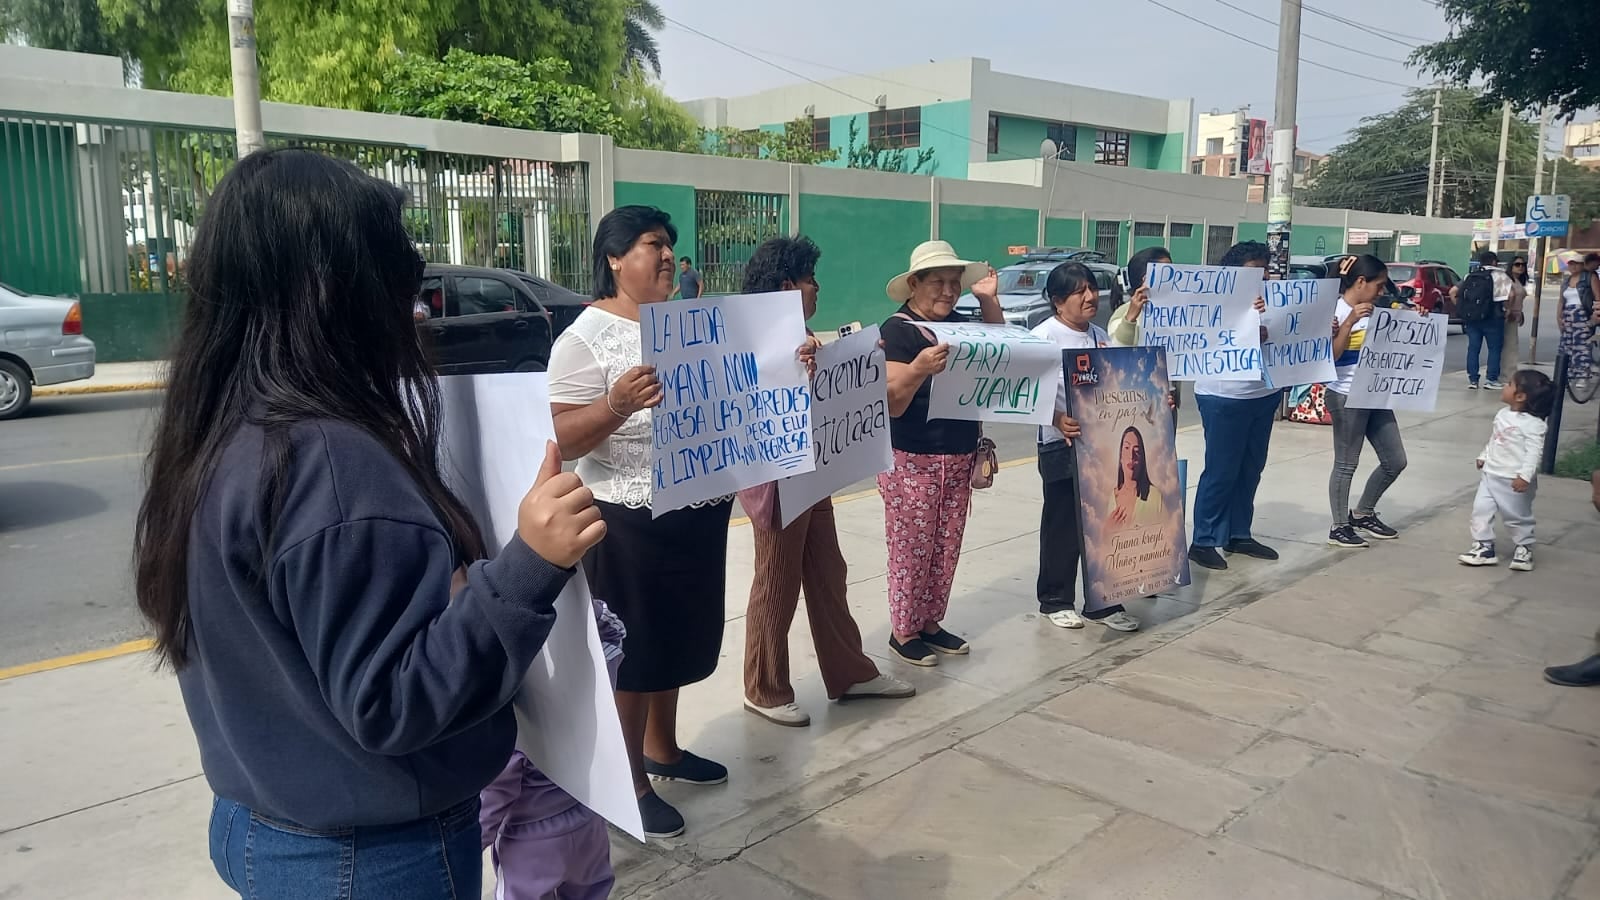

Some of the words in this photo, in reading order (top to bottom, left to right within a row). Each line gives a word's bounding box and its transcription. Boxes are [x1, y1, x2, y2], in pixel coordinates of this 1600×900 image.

[1143, 300, 1222, 328] PREVENTIVA
[1284, 311, 1302, 336] DE
[1373, 310, 1440, 345] PRISIÓN
[651, 306, 672, 354] LA
[679, 306, 727, 349] VIDA
[1145, 331, 1208, 353] MIENTRAS
[1219, 329, 1237, 347] SE
[950, 341, 1011, 374] PARA
[1359, 346, 1415, 370] PREVENTIVA
[959, 376, 1040, 412] JUANA!
[1368, 373, 1425, 396] JUSTICIA
[712, 399, 743, 432] LAS
[745, 386, 810, 420] PAREDES
[745, 418, 776, 444] PERO
[782, 414, 808, 433] ELLA
